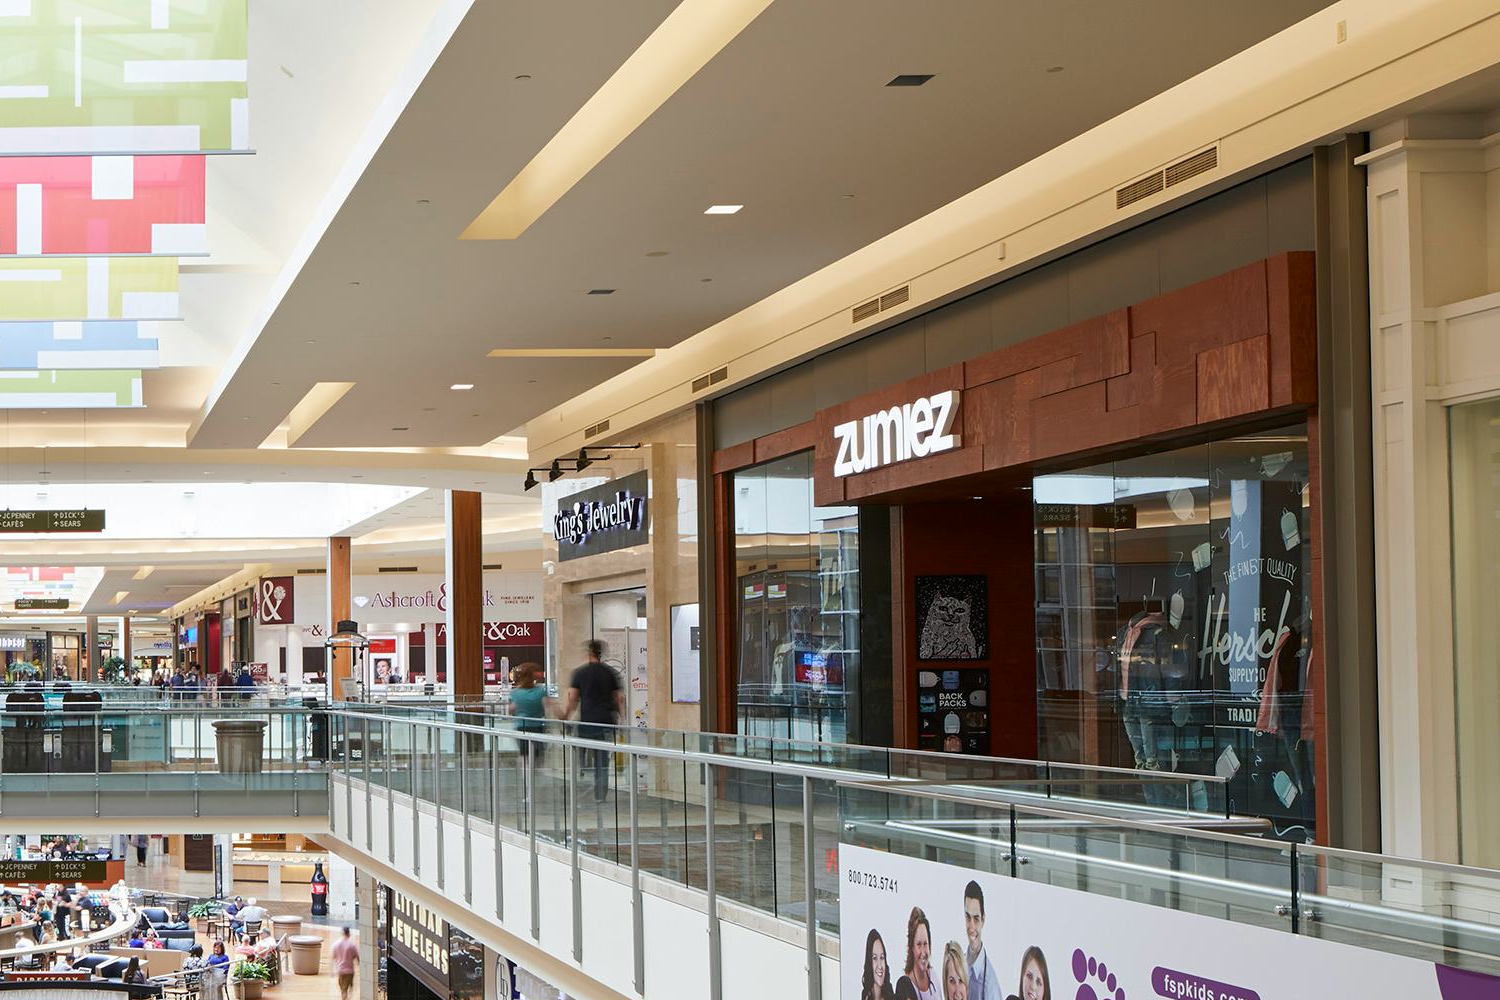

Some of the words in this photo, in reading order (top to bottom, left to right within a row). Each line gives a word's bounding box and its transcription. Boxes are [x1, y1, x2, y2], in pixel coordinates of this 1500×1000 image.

[554, 502, 583, 544] King's
[587, 492, 635, 530] Jewelry
[1223, 566, 1238, 585] THE
[1266, 558, 1297, 585] QUALITY
[371, 590, 436, 608] Ashcroft
[487, 622, 506, 640] &
[506, 624, 530, 637] Oak
[1229, 668, 1254, 682] SUPPLY
[939, 692, 963, 700] BACK
[849, 869, 898, 893] 800.723.5741
[394, 889, 443, 938] LITTMAN
[391, 916, 448, 975] JEWELERS
